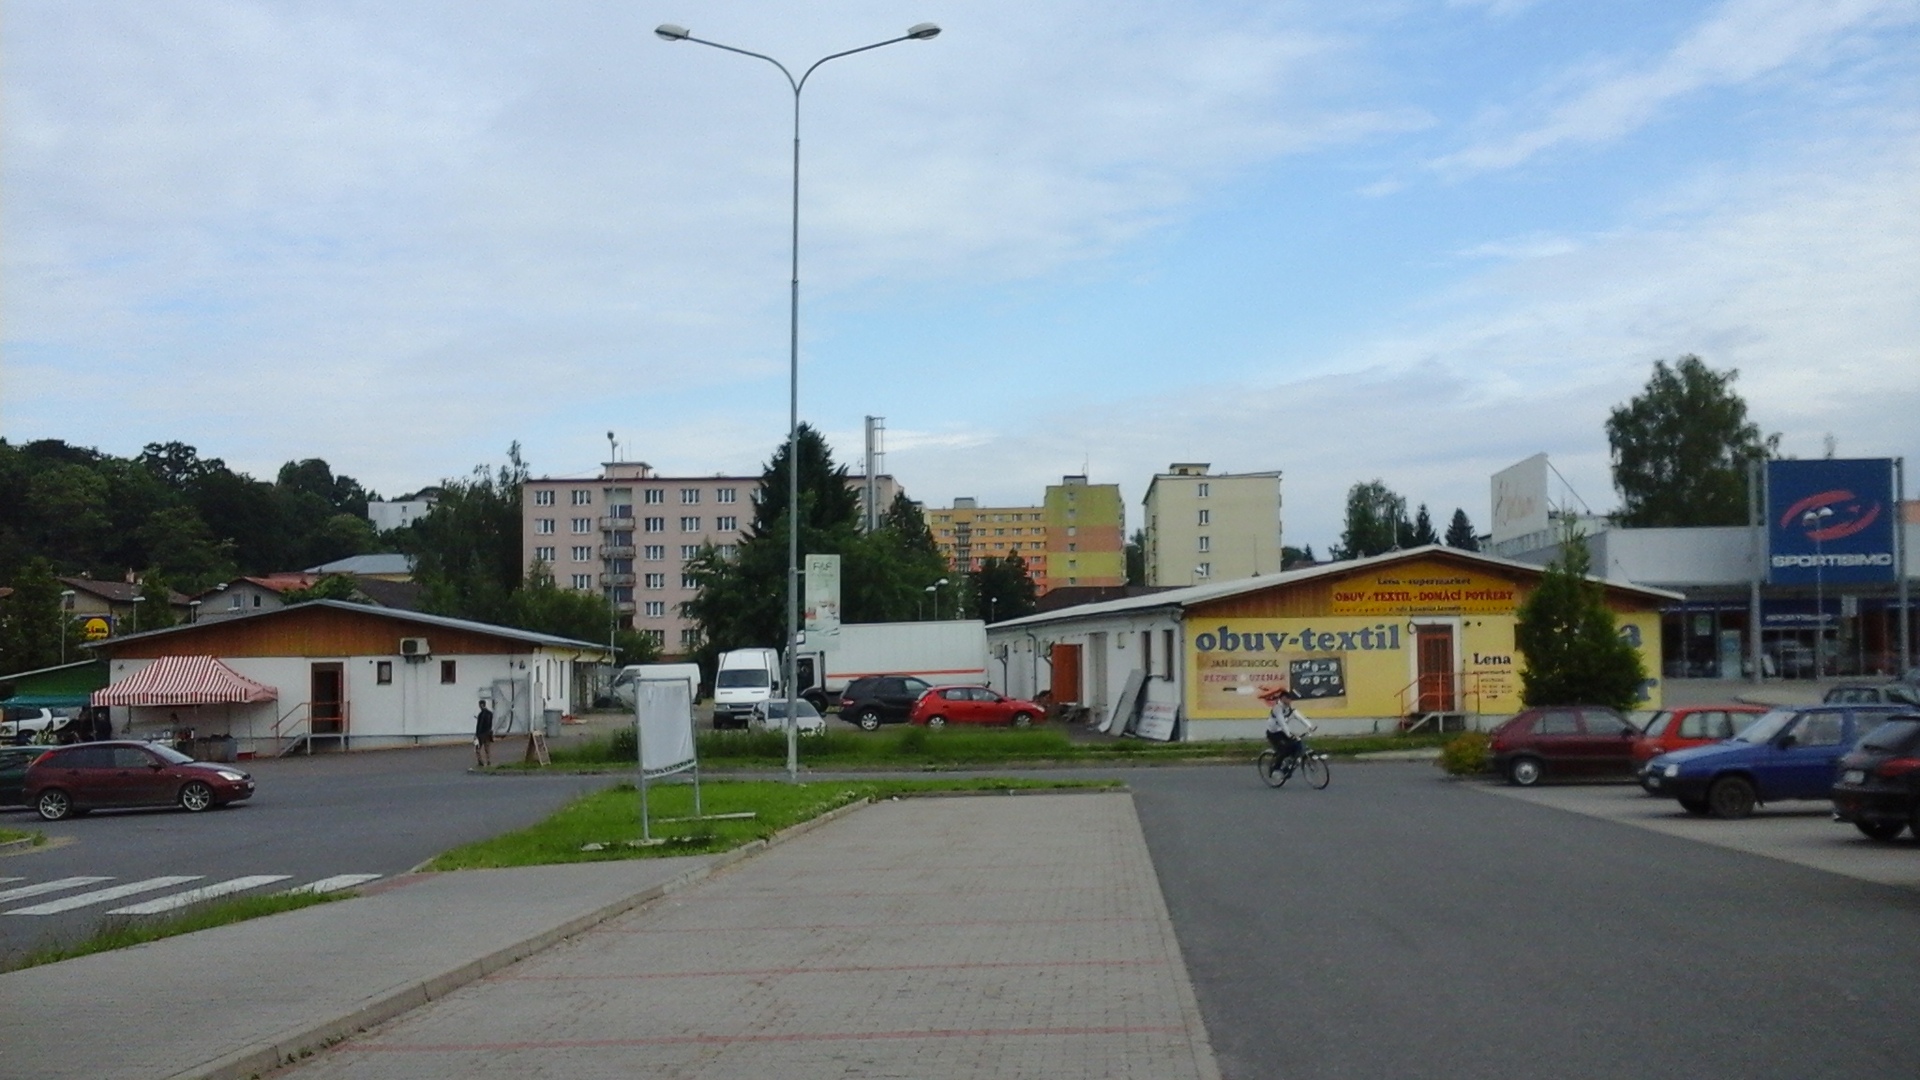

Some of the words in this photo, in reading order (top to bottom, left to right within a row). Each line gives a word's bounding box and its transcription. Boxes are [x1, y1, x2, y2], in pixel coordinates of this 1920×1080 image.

[1335, 592, 1364, 602] OBUV
[1373, 591, 1412, 602] TEXTIL
[1419, 589, 1460, 601] DOMÁCÍ
[1465, 588, 1513, 601] POTŘEBY
[1195, 625, 1400, 652] obuv-textil
[1473, 653, 1512, 665] Lena
